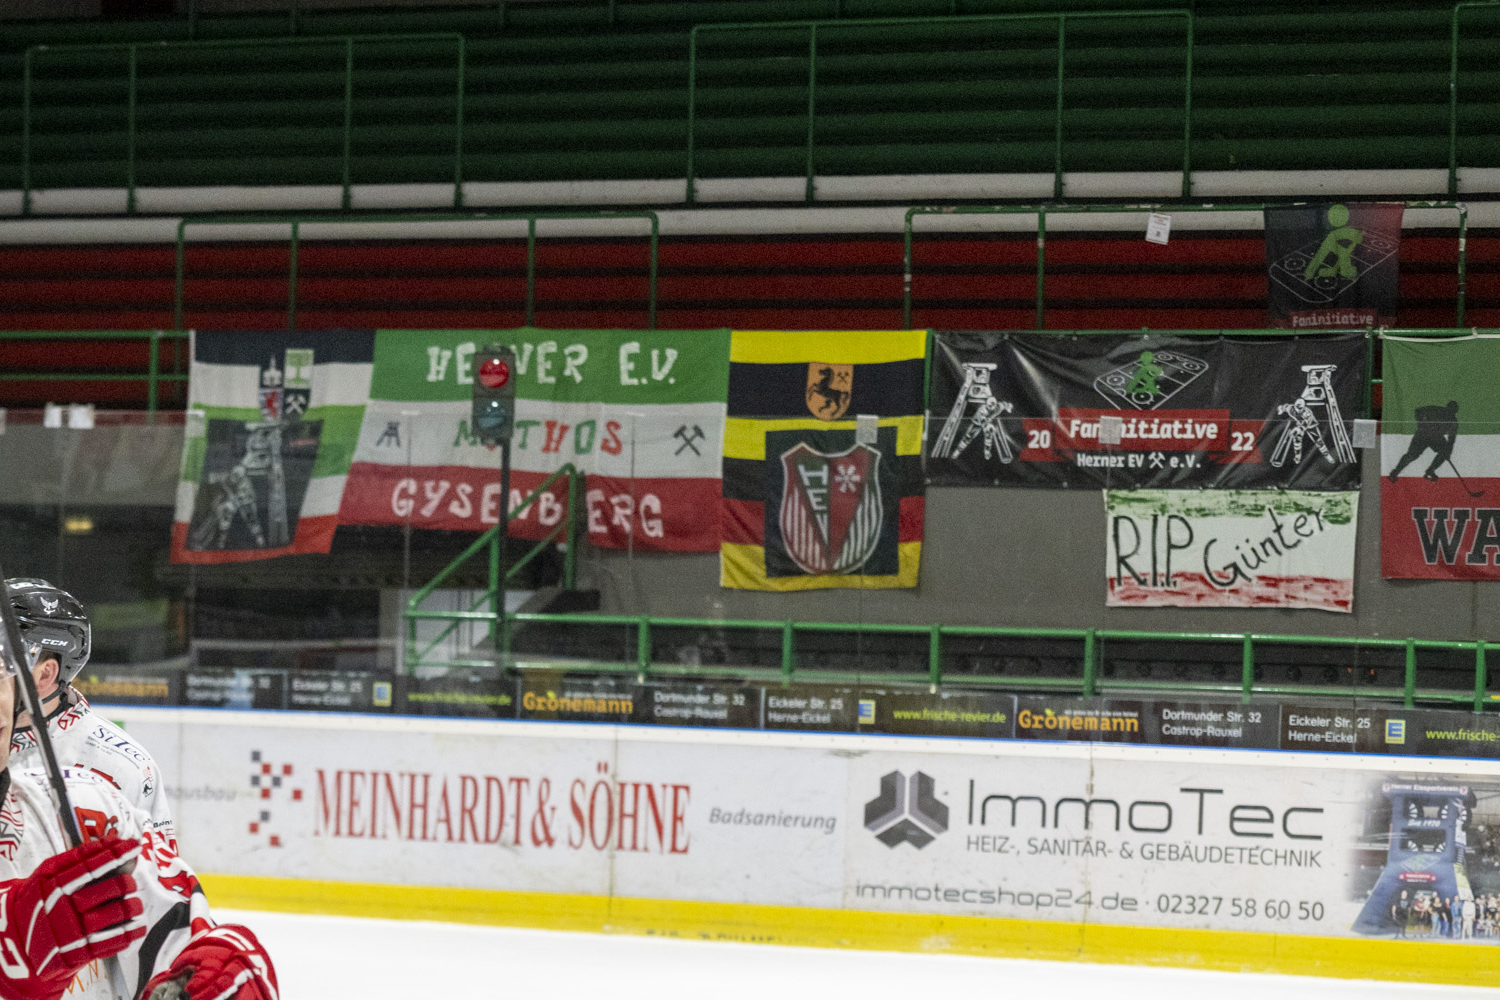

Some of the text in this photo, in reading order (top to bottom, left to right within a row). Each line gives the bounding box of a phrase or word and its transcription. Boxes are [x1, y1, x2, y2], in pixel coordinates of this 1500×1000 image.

[1291, 310, 1375, 328] Faninitiative
[426, 341, 678, 386] HENER E.V.
[453, 418, 623, 456] MTHOS
[1028, 418, 1255, 451] 20 Fannitiative 22
[1077, 453, 1201, 468] Herner EV e.V.
[1203, 505, 1328, 589] Günter
[41, 637, 69, 648] CCM
[1162, 709, 1262, 724] Dortmunder Str. 32
[1288, 714, 1371, 730] Eickeler Str. 25
[1162, 724, 1243, 739] Castrop-Rauxel
[1288, 729, 1358, 744] Herne-Eickel
[1425, 728, 1500, 743] www.frische-
[313, 762, 692, 856] MEINHARDT & SÖHNE
[709, 807, 837, 835] Badsanierung
[967, 779, 1325, 841] ImmoTec
[966, 834, 1322, 868] HEIZ-, SANITÄR- & GEBÄUDETECHNIK
[855, 881, 1326, 921] immotecshop24.de 02327 58 60 50
